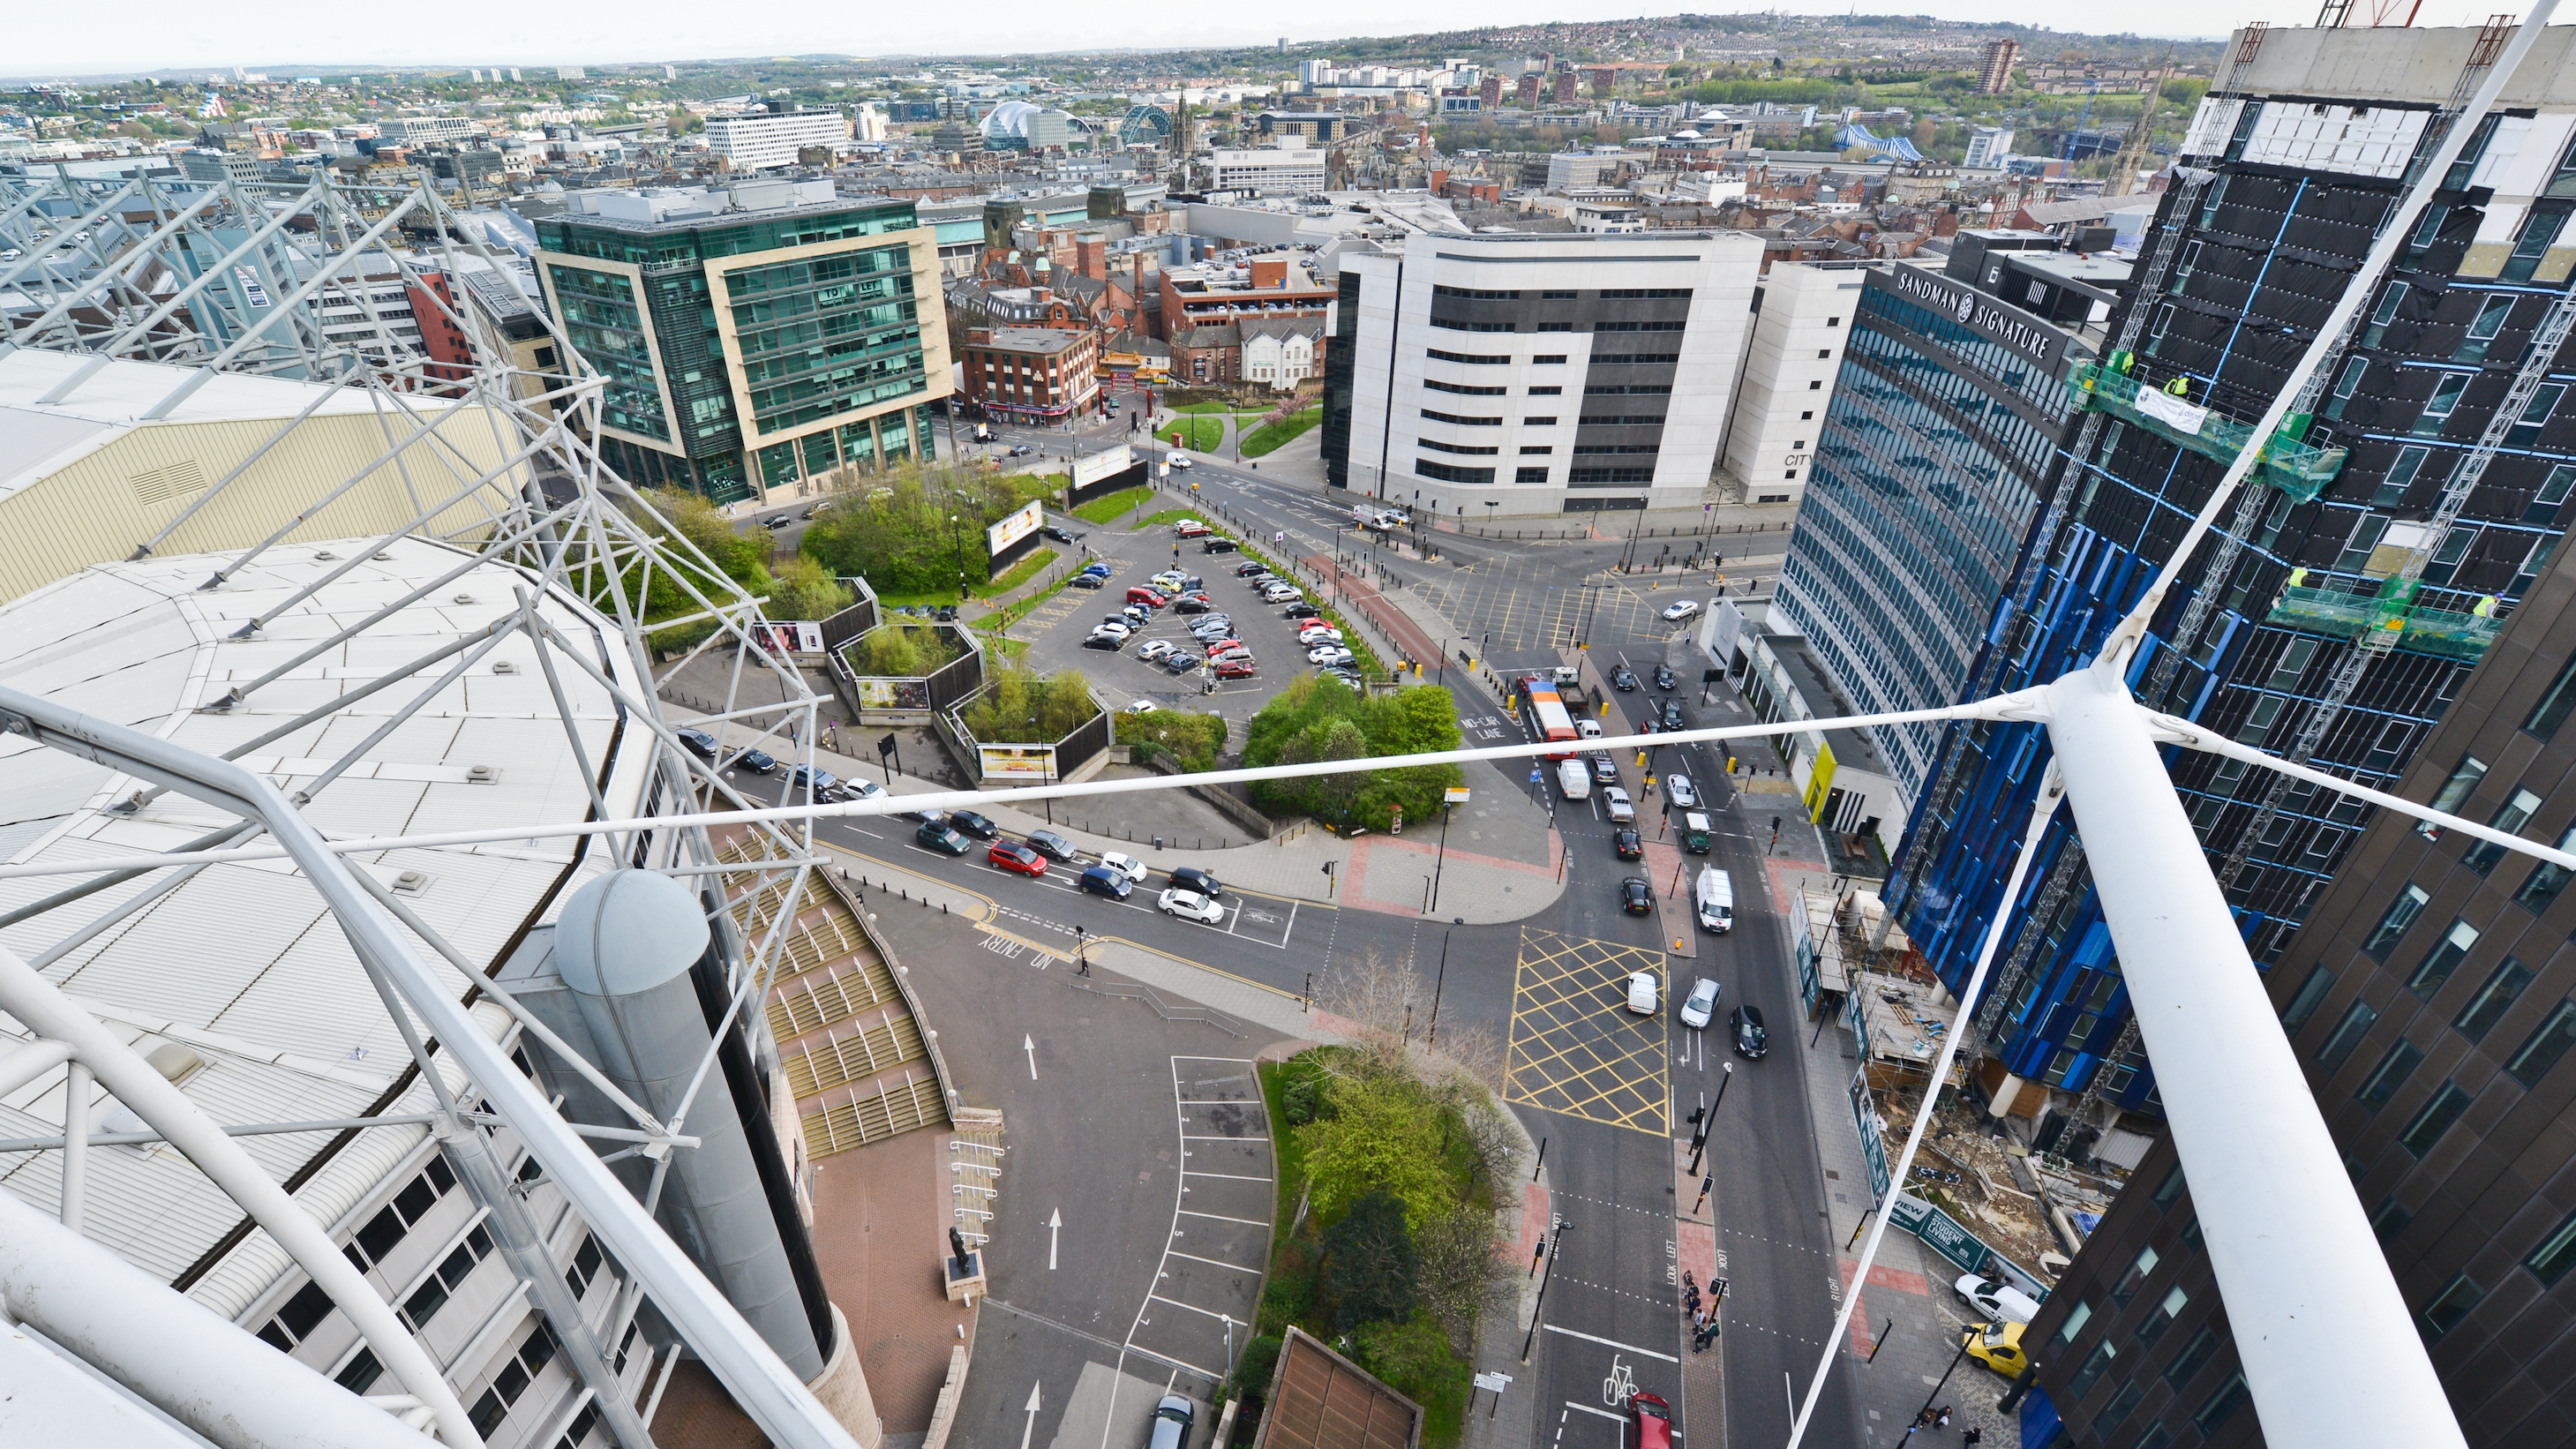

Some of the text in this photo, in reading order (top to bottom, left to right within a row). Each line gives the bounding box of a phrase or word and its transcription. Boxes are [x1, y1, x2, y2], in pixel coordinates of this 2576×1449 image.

[824, 281, 877, 297] TO LET
[1898, 273, 2049, 359] SANDMAN SIGNATURE
[1461, 716, 1501, 729] NO-CAR
[1476, 727, 1506, 740] LANE
[978, 935, 1056, 971] NO ENTRY
[1895, 1200, 1924, 1215] VIEW
[1551, 1213, 1562, 1231] LOOK
[1931, 1218, 1964, 1245] STUDENT
[1926, 1223, 1952, 1245] LIVING
[1665, 1238, 1677, 1286] LOOK LEFT
[1716, 1249, 1731, 1299] LOOK LFT
[1829, 1277, 1841, 1302] RIGHT
